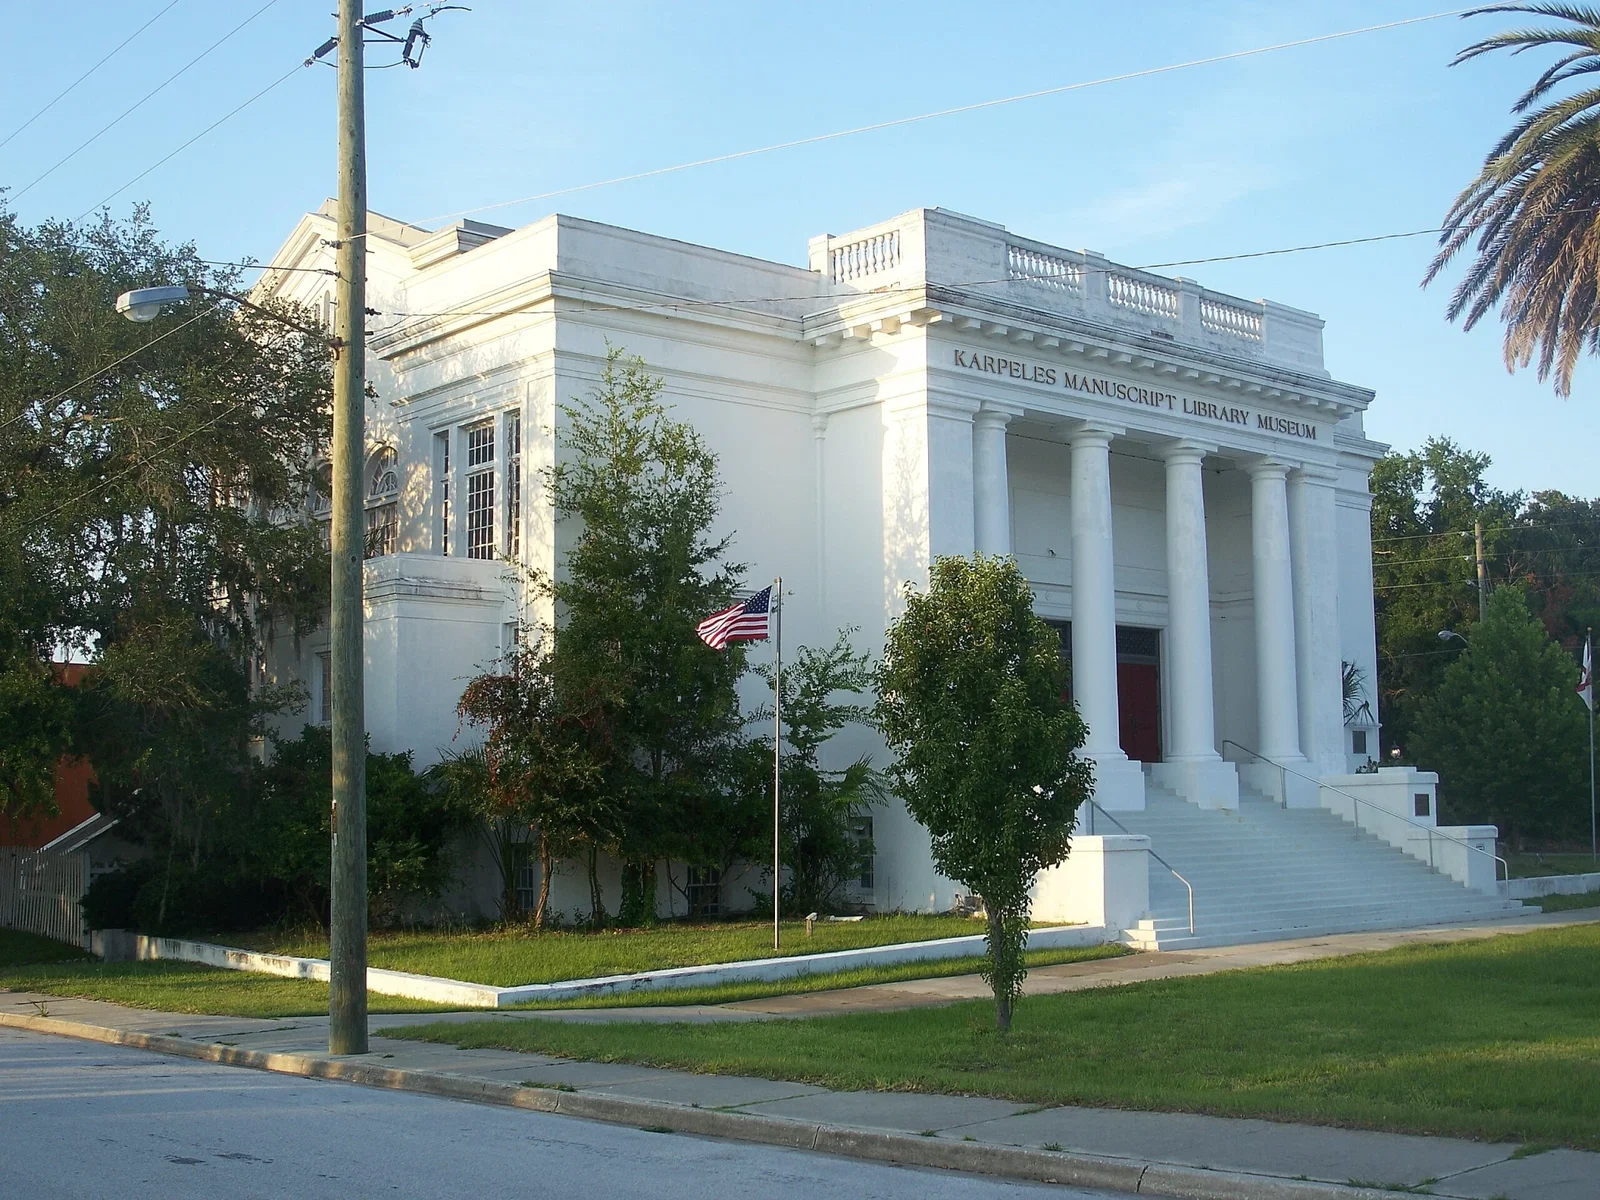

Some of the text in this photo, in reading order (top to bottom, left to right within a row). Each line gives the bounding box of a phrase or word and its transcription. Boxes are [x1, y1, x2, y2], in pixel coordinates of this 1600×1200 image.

[954, 349, 1317, 440] KARPELES MANUSCRIPT LIBRARY MUSEUM
